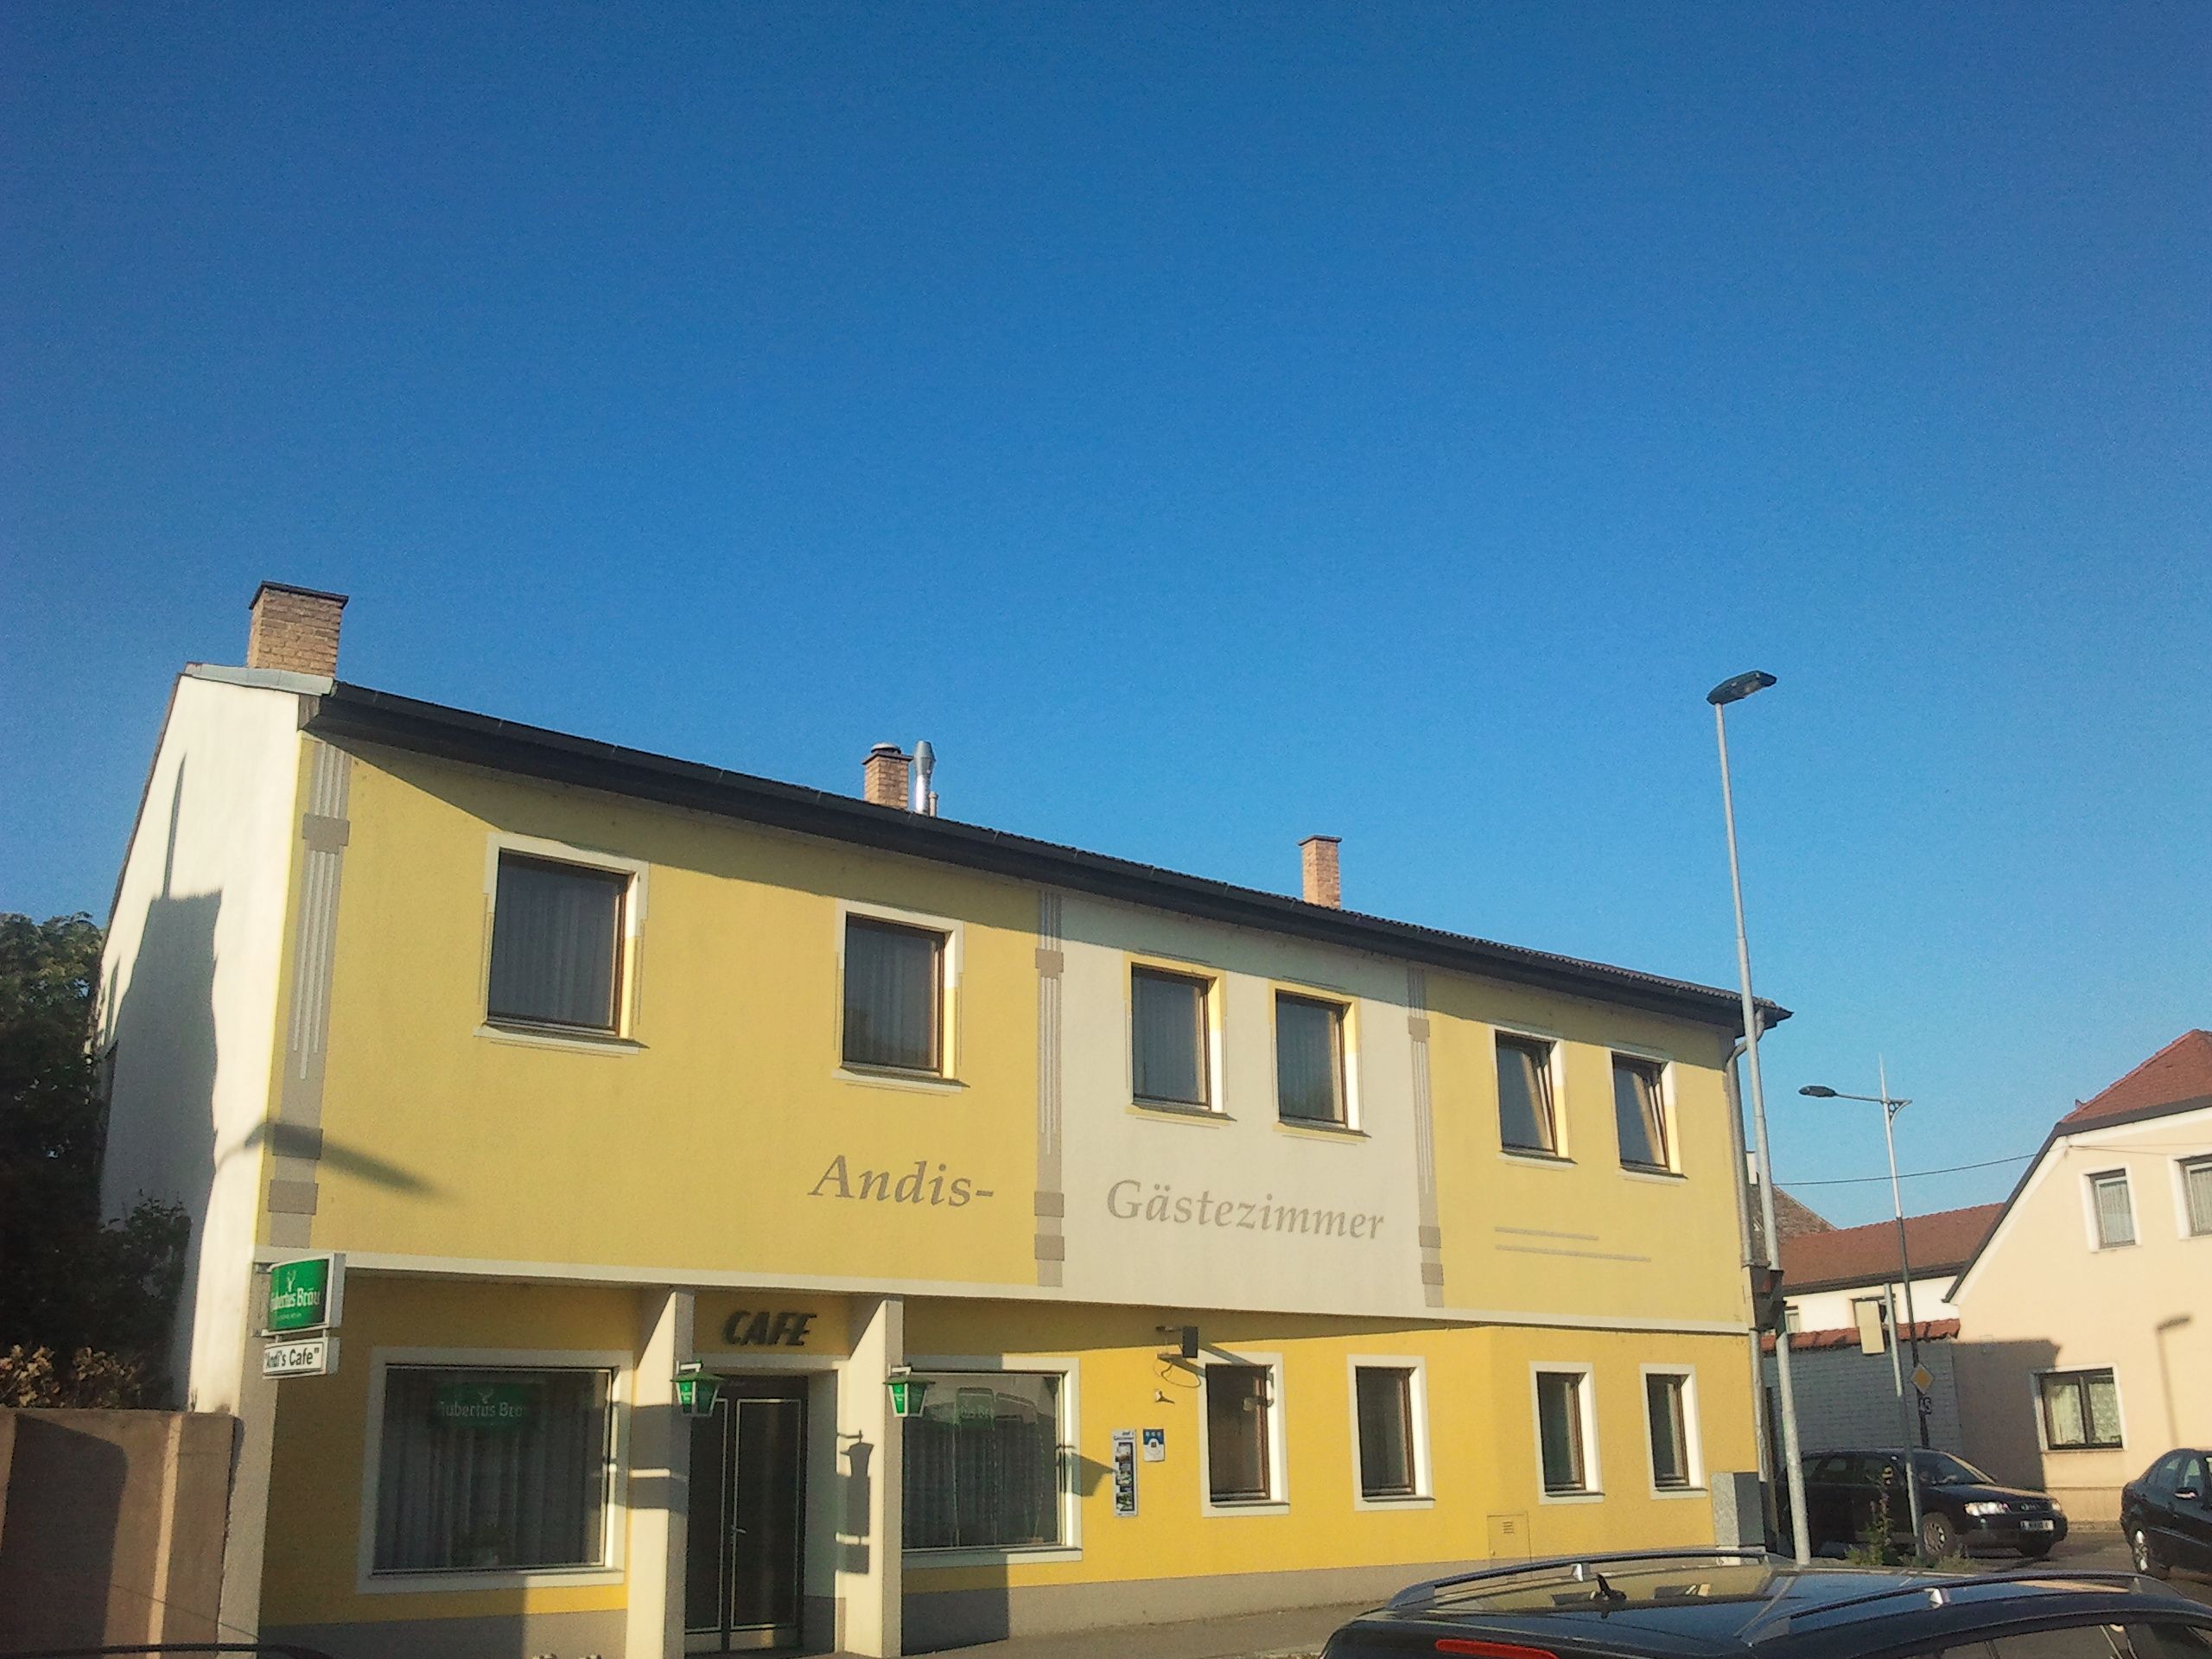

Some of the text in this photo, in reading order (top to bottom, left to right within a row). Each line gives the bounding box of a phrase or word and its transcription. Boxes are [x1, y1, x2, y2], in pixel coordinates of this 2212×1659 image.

[808, 1154, 995, 1207] Andis-
[1106, 1179, 1384, 1241] Gästezimmer
[722, 1311, 817, 1346] CAFE
